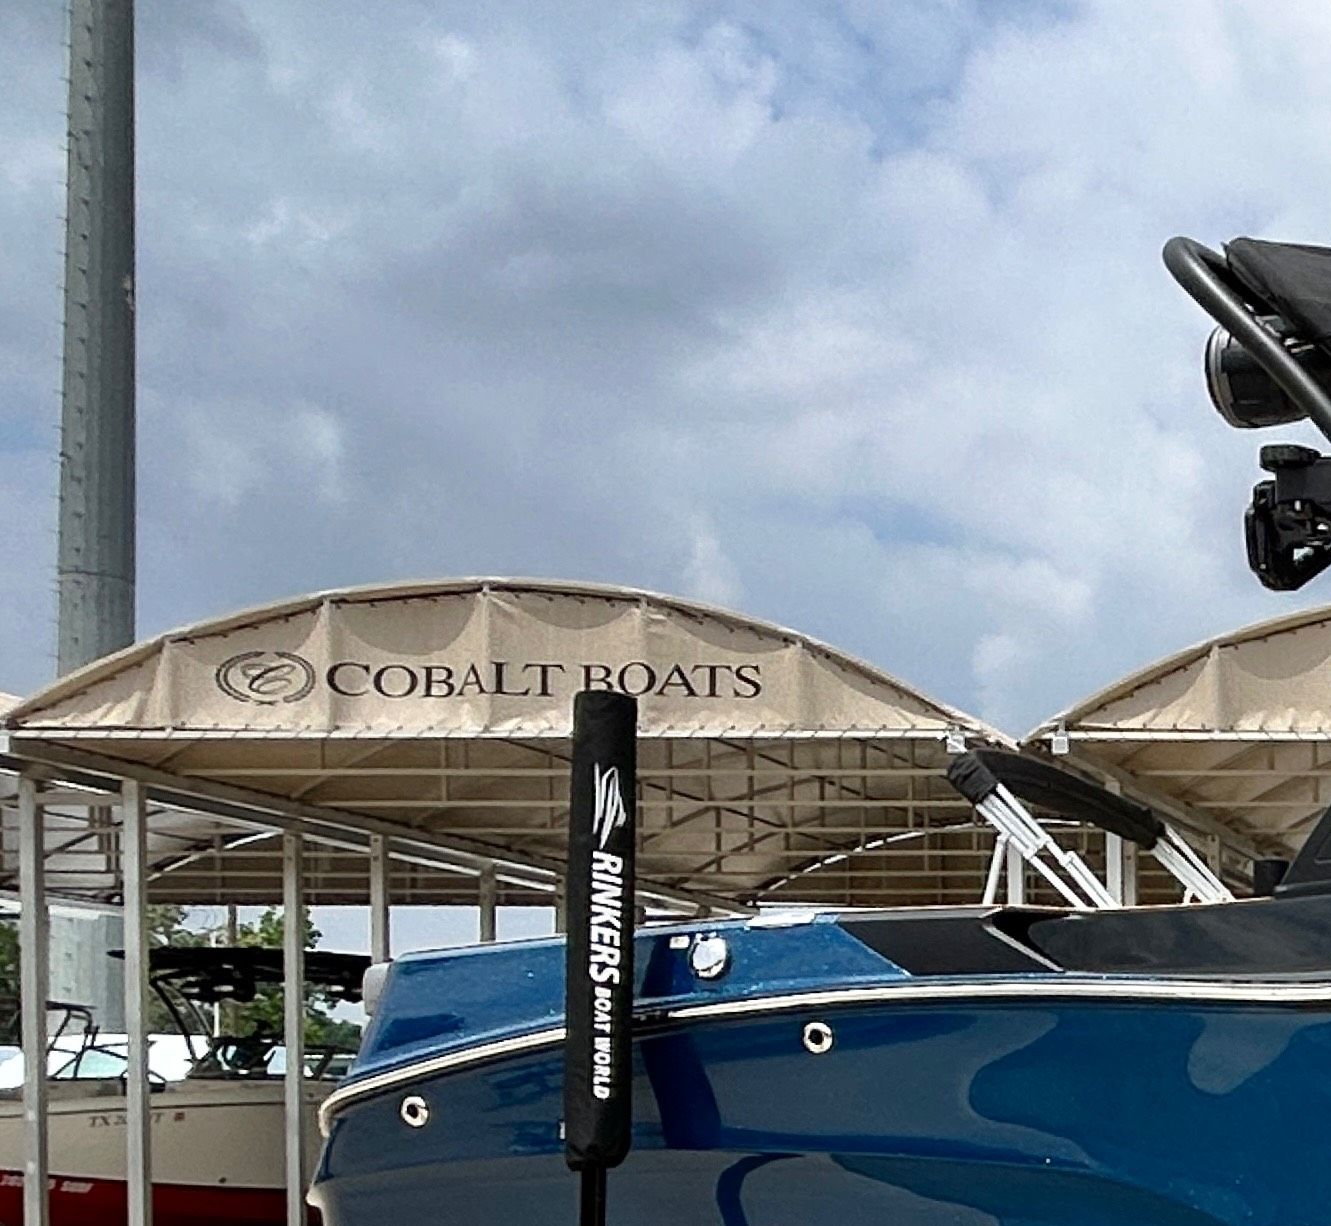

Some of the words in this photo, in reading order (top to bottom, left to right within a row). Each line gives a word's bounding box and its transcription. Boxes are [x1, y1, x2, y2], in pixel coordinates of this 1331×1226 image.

[326, 661, 565, 699] COBALT
[578, 661, 762, 699] BOATS
[588, 850, 624, 985] RINKERS
[593, 986, 612, 1034] BOAT
[592, 1036, 612, 1100] WORLD
